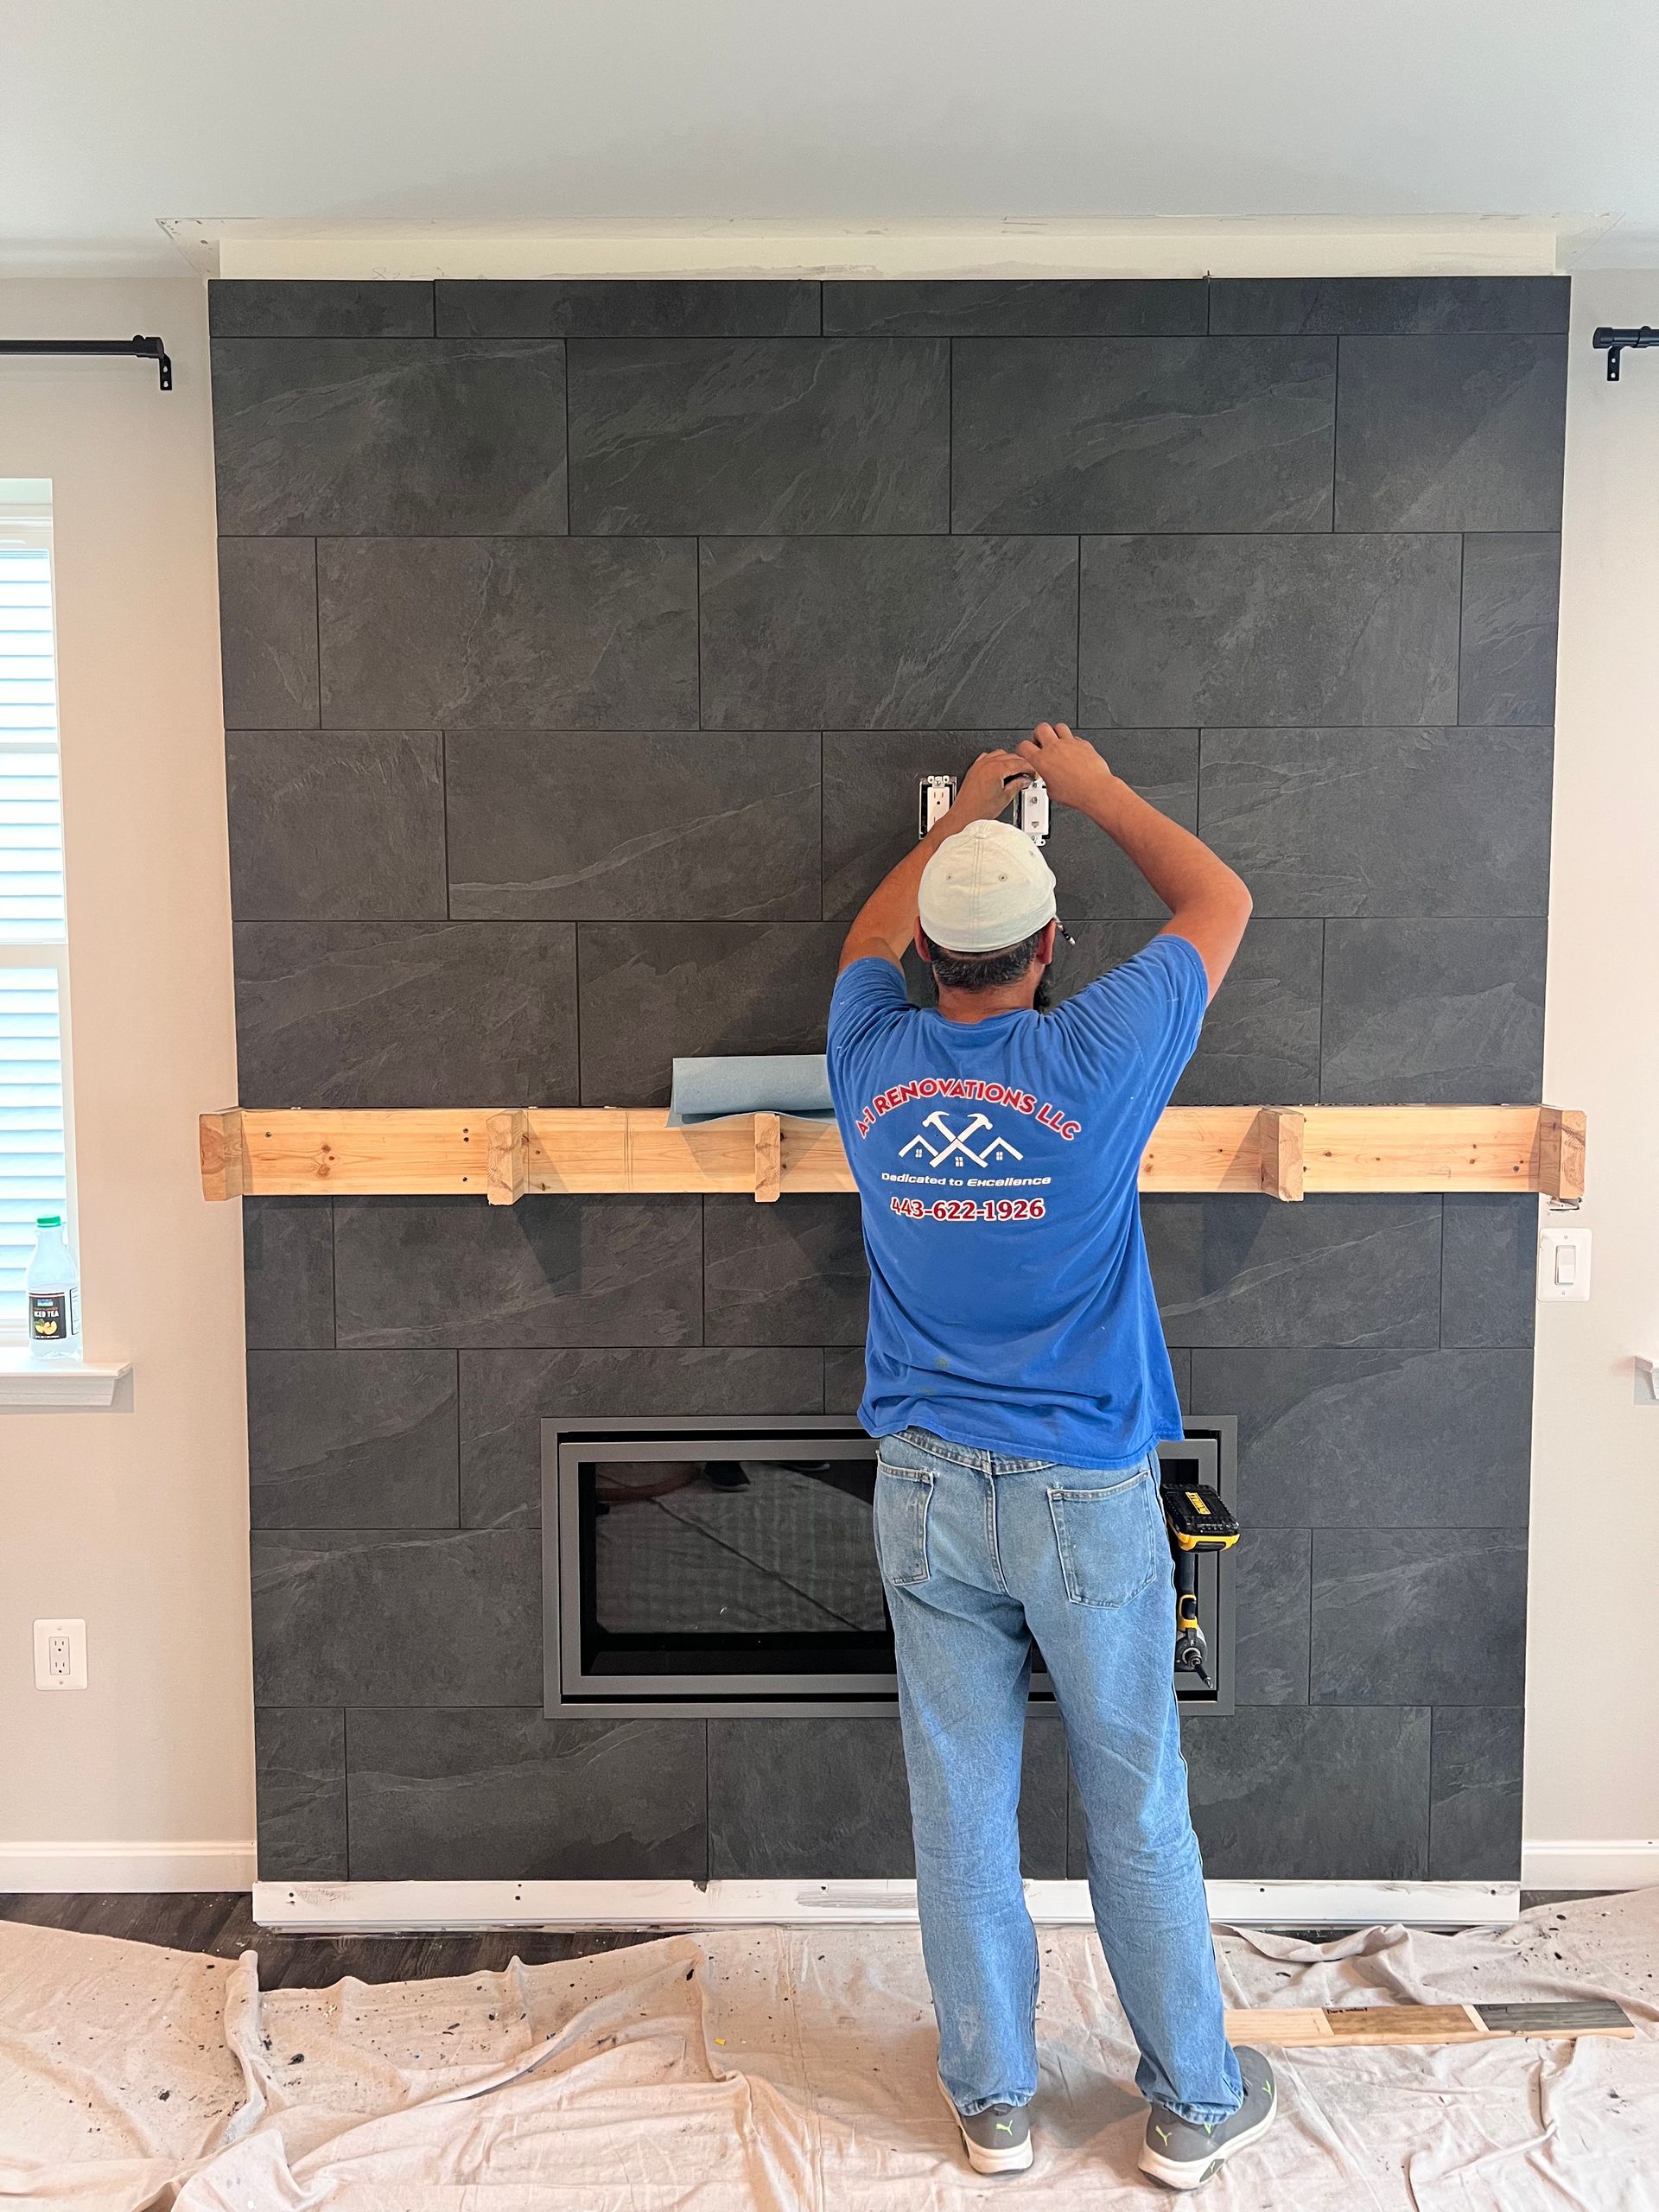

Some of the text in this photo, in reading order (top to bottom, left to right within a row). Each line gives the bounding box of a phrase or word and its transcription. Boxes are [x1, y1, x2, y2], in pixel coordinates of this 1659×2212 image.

[855, 1078, 1081, 1141] A-1 RENOVATIONS LLC
[881, 1173, 1052, 1187] Dedicated to Excellence
[890, 1196, 1046, 1221] 443-622-1926
